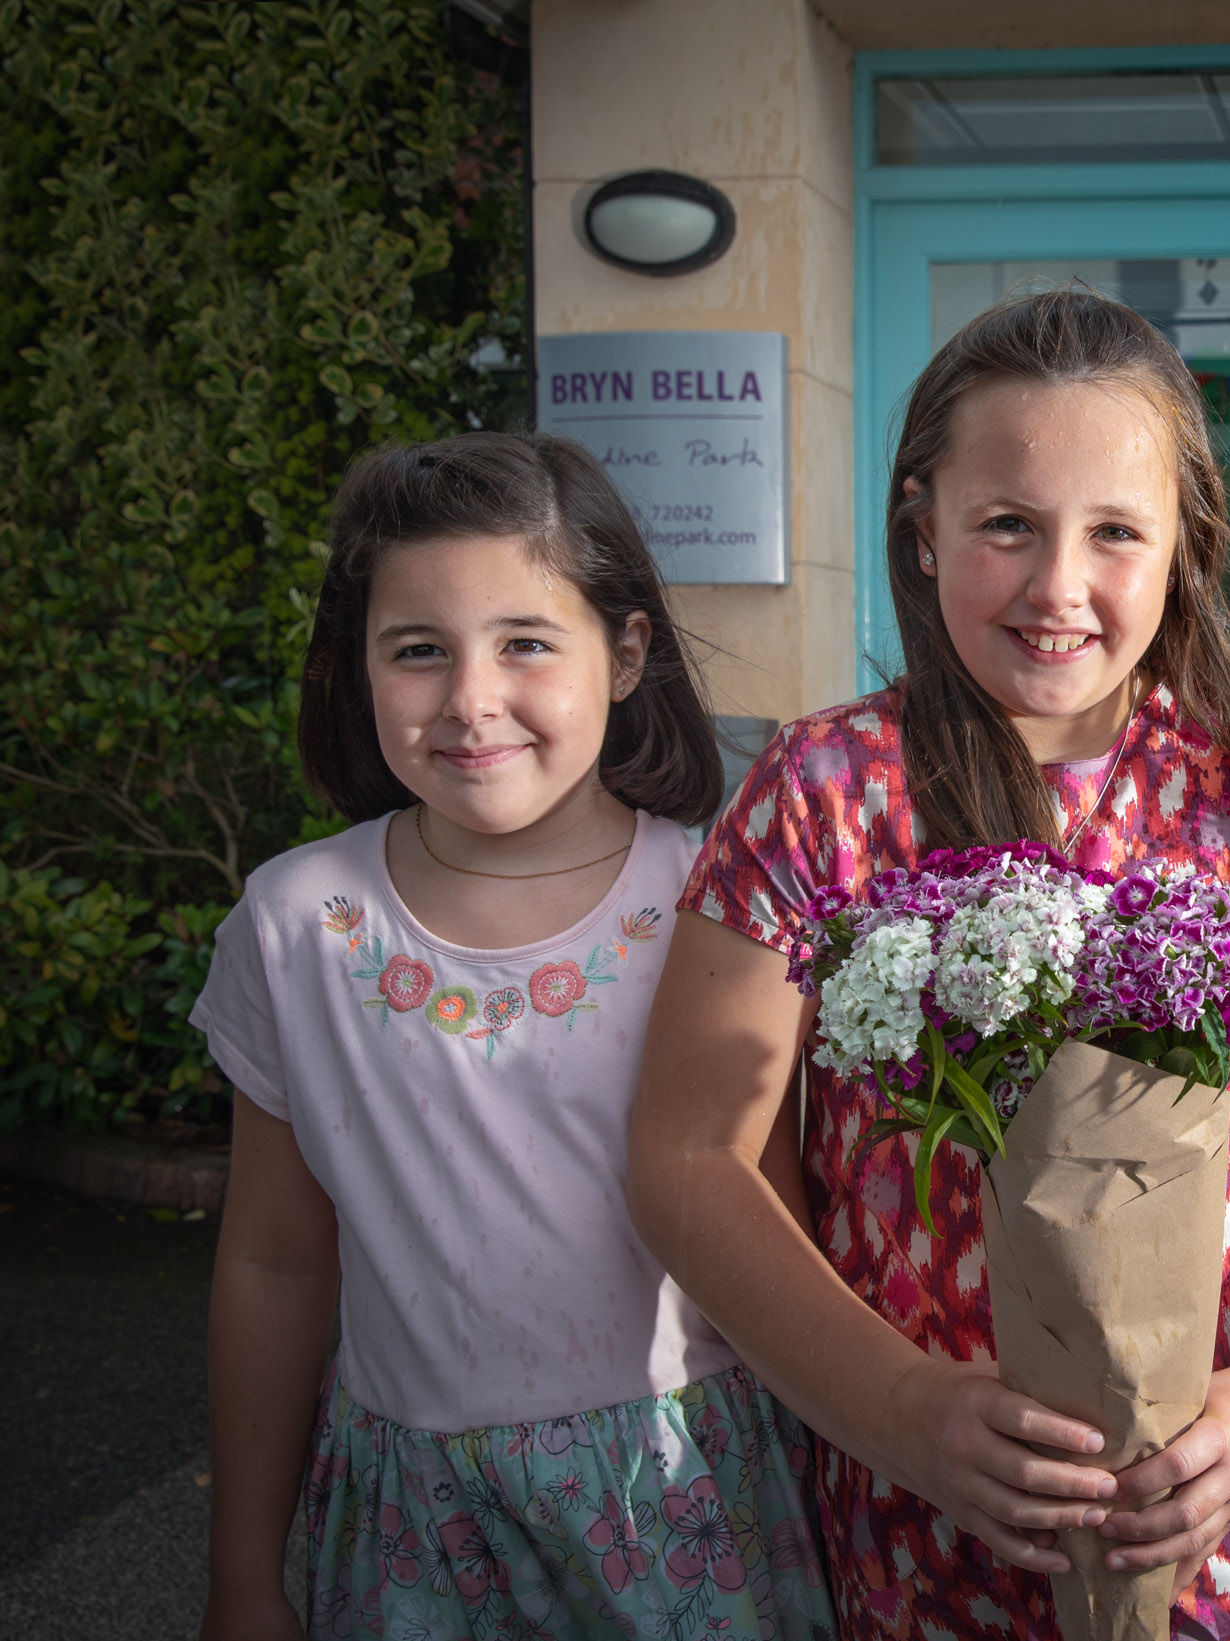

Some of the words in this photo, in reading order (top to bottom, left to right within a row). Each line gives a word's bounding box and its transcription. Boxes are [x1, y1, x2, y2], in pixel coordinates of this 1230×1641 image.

[551, 371, 633, 404] BRYN
[652, 370, 762, 402] BELLA
[684, 438, 763, 467] Park
[651, 504, 714, 522] 720242
